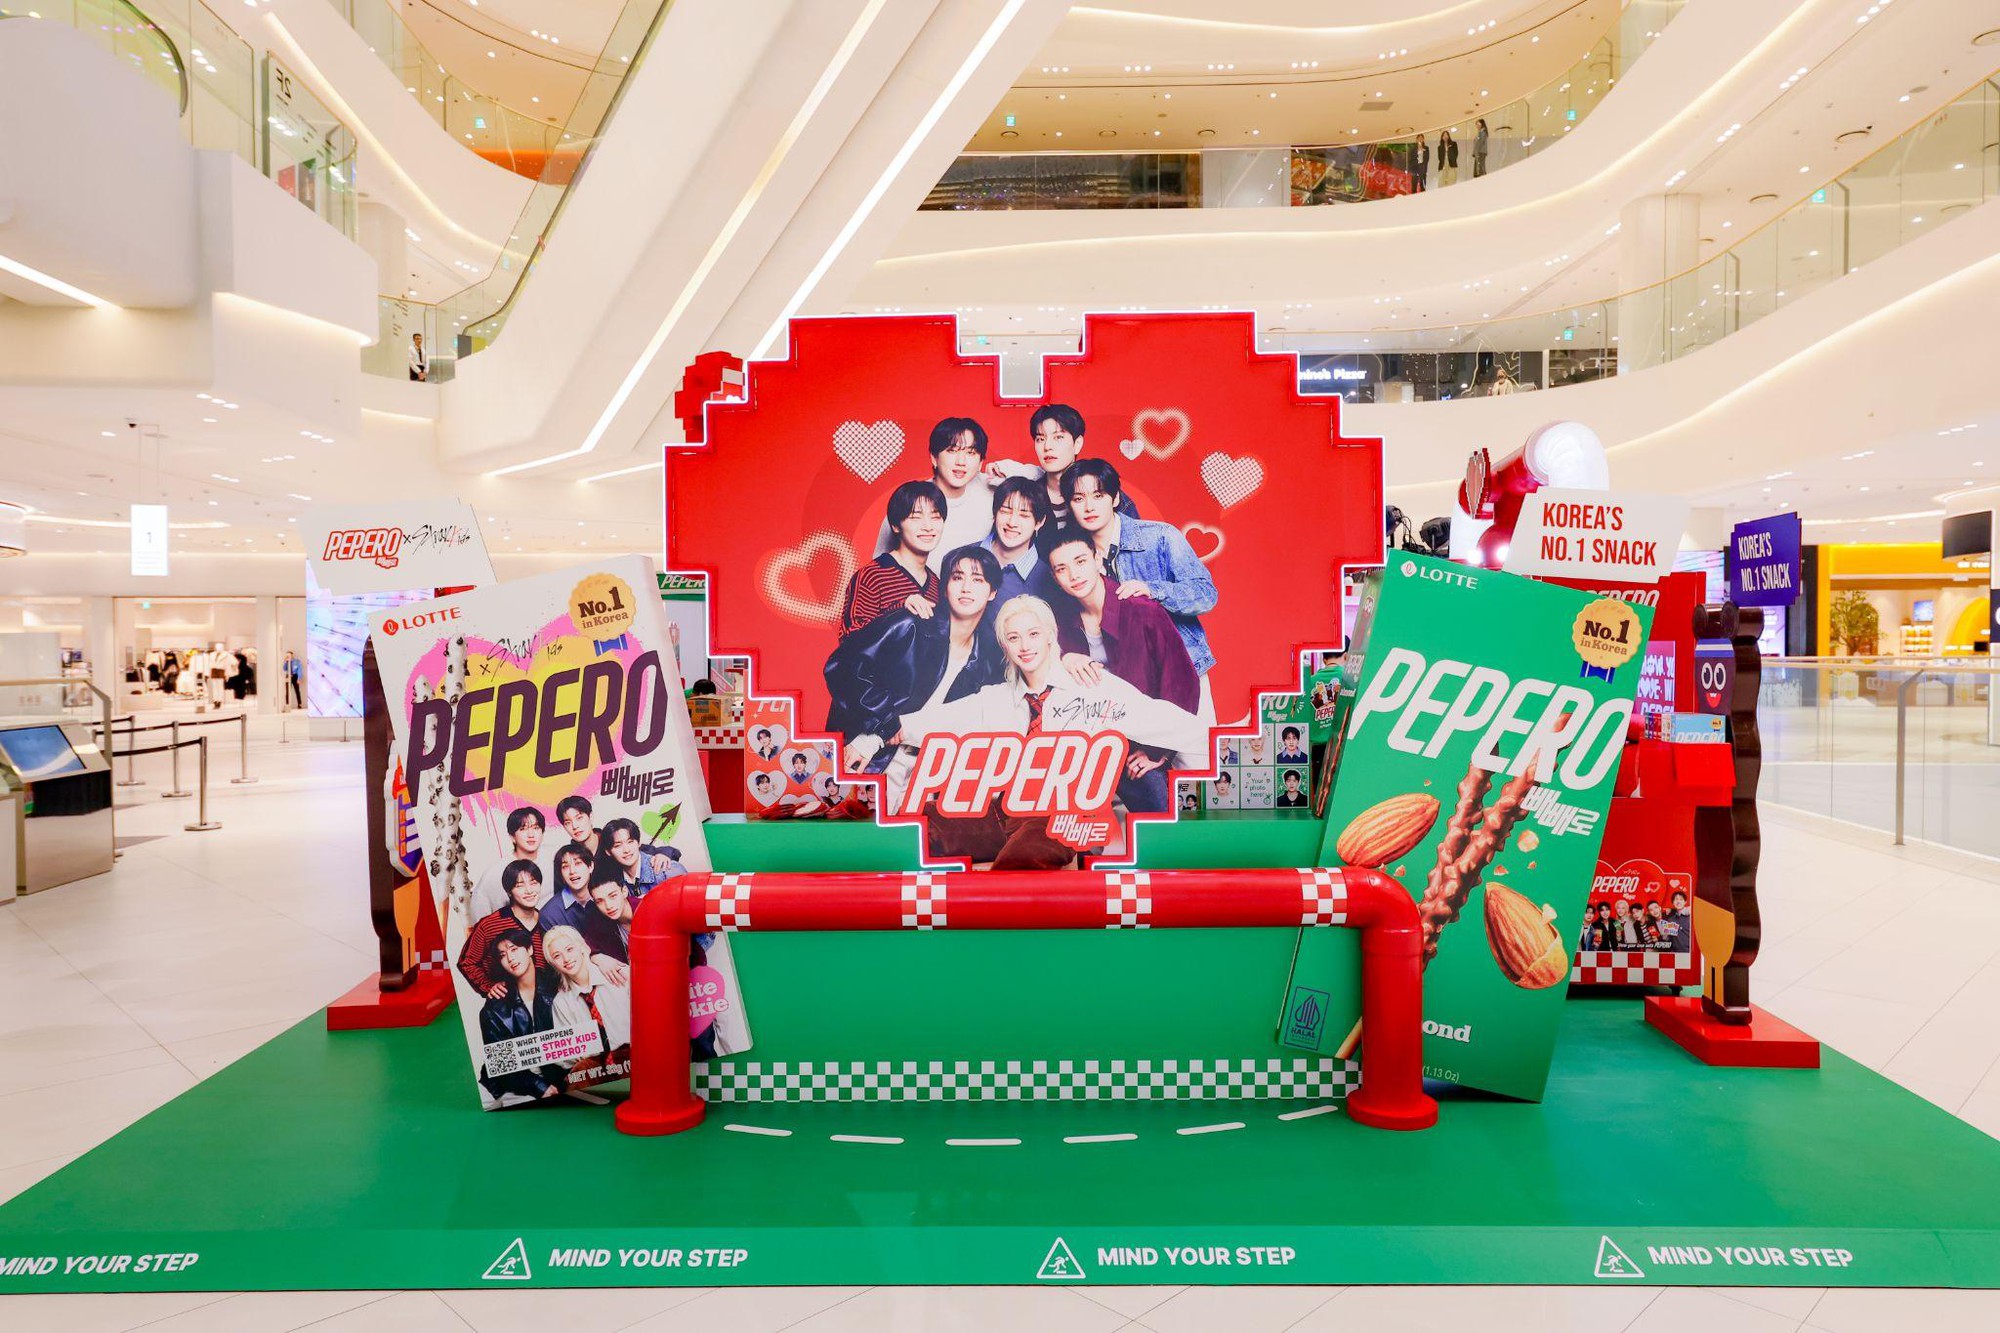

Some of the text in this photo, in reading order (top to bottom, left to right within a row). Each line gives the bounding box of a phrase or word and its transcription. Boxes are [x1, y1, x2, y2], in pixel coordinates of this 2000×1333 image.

[1542, 502, 1623, 531] KOREA'S
[324, 528, 402, 560] PEPERO
[1592, 539, 1657, 566] SNACK
[1738, 531, 1772, 561] KOREA'S
[1419, 565, 1479, 590] LOTTE
[1762, 562, 1791, 590] SNACK
[578, 586, 625, 619] No.1
[402, 606, 462, 630] LOTTE
[593, 611, 629, 626] Korea
[1583, 619, 1630, 644] No.1
[1592, 639, 1628, 656] Korea
[405, 650, 668, 808] PEPERO
[1347, 647, 1634, 790] PEPERO
[600, 766, 675, 806] 빼빼로
[904, 734, 1125, 813] PEPERO
[1520, 785, 1600, 836] 빼빼로
[1051, 814, 1109, 846] 빼빼로
[1591, 876, 1640, 893] PEPERO
[516, 1028, 574, 1048] WHAT HAPPENS
[517, 1032, 598, 1058] WHEN STRAY KIDS
[521, 1044, 587, 1067] MEET PEPERO?
[567, 1070, 586, 1083] NET
[63, 1255, 132, 1275] YOUR
[133, 1253, 199, 1272] STEP
[548, 1248, 748, 1267] MIND YOUR STEP
[1097, 1246, 1296, 1266] MIND YOUR STEP
[1647, 1246, 1853, 1267] MIND YOUR STEP
